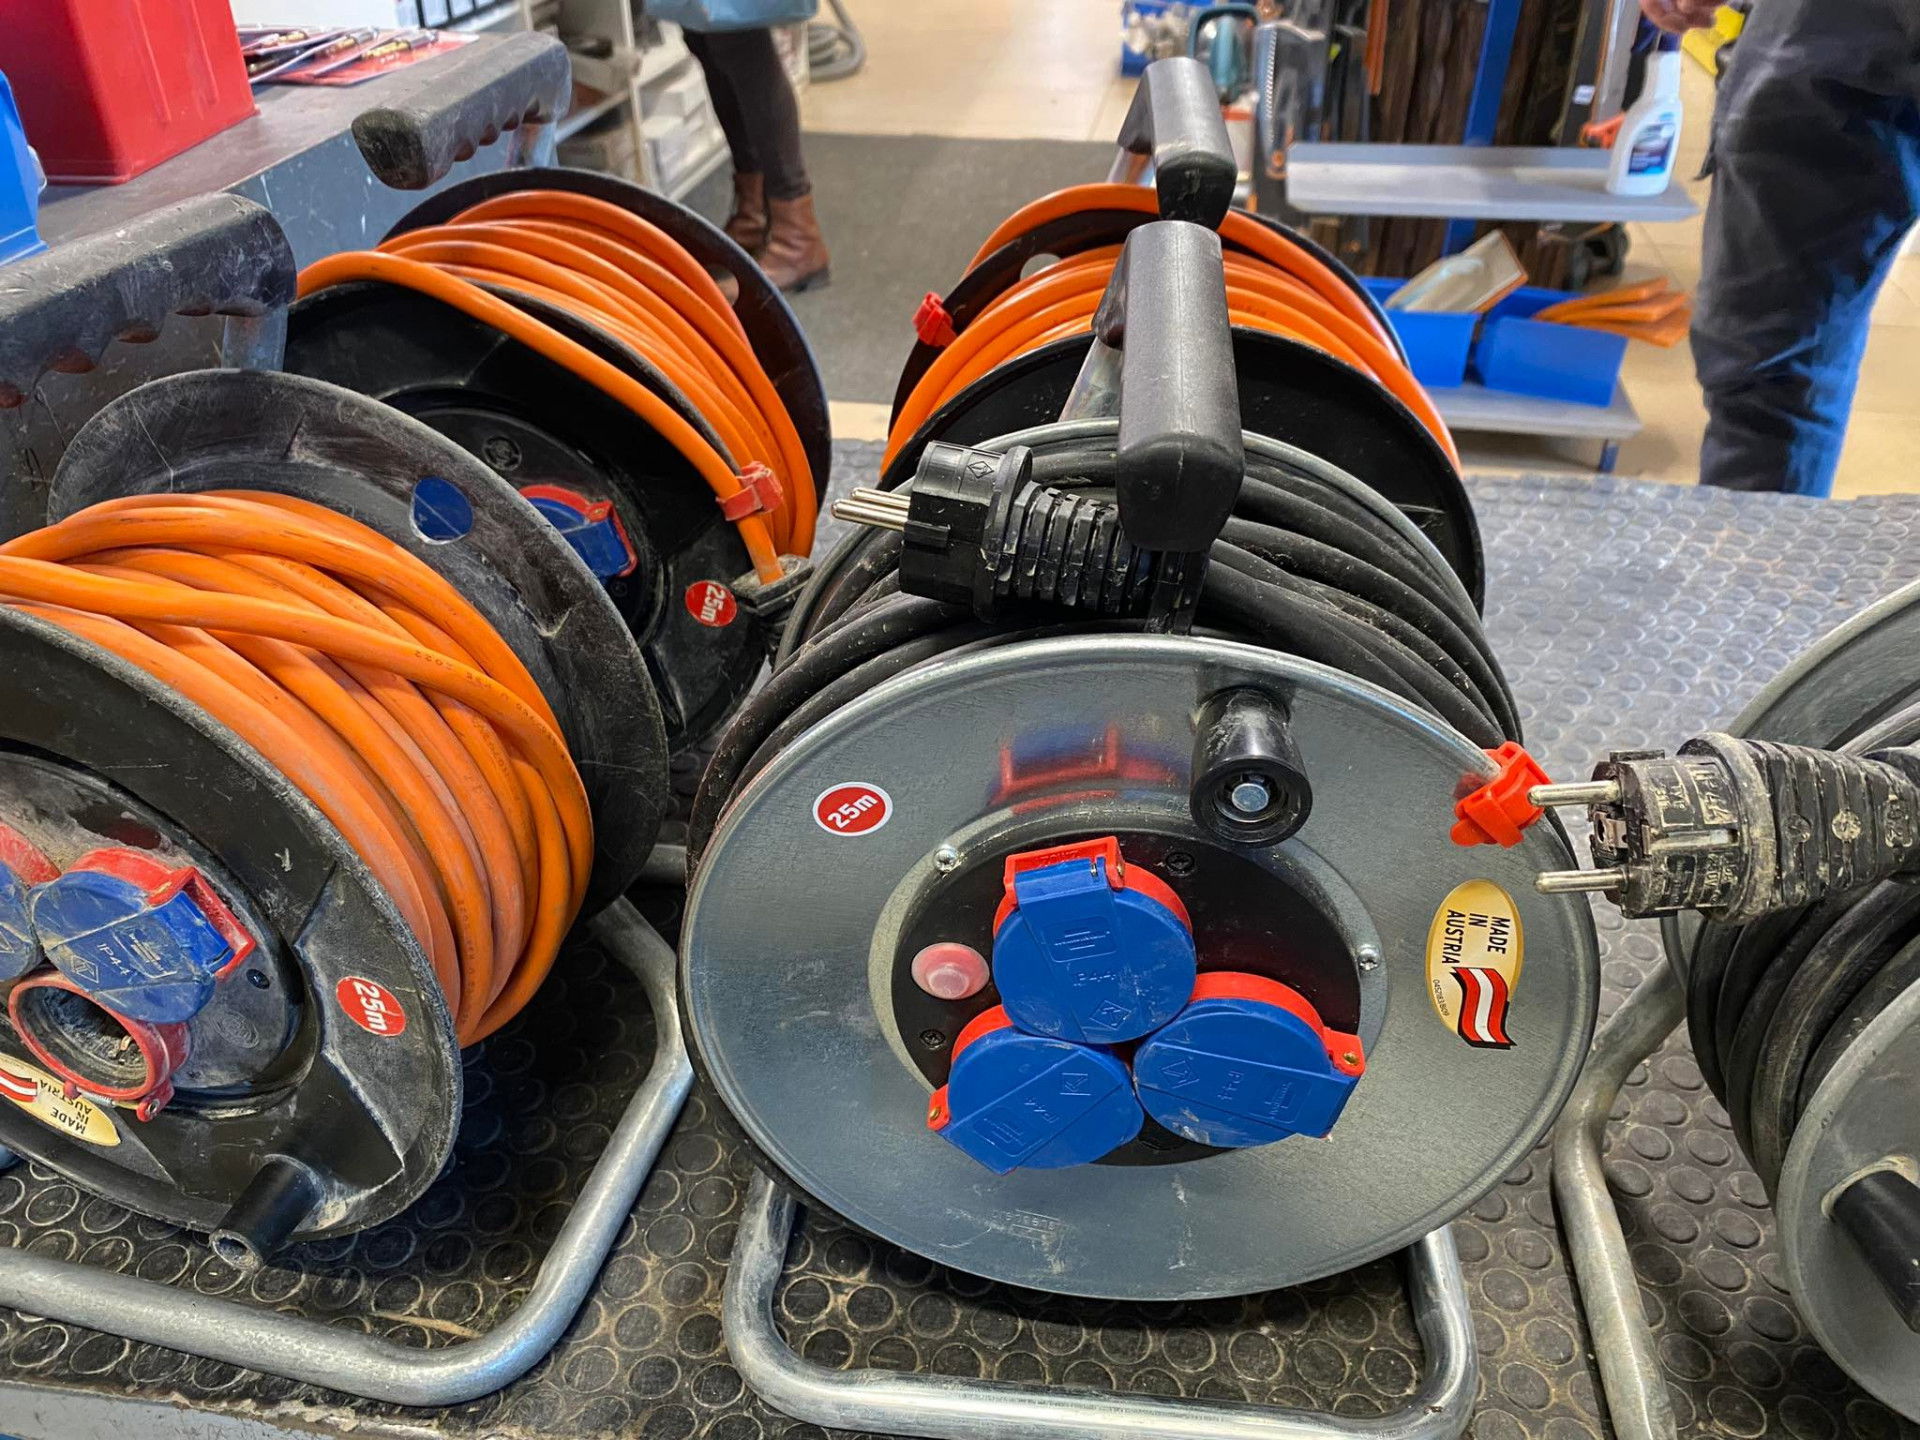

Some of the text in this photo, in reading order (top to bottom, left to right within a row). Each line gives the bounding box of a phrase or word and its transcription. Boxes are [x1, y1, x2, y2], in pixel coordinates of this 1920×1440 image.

[700, 584, 726, 622] 25m
[827, 794, 878, 829] 25m
[1441, 909, 1467, 964] AUSTRIA
[1468, 912, 1489, 928] IN
[1487, 916, 1511, 954] MADE
[97, 943, 131, 976] IP44
[352, 981, 388, 1031] 25m
[50, 1107, 86, 1134] MADE
[75, 1111, 89, 1125] IN
